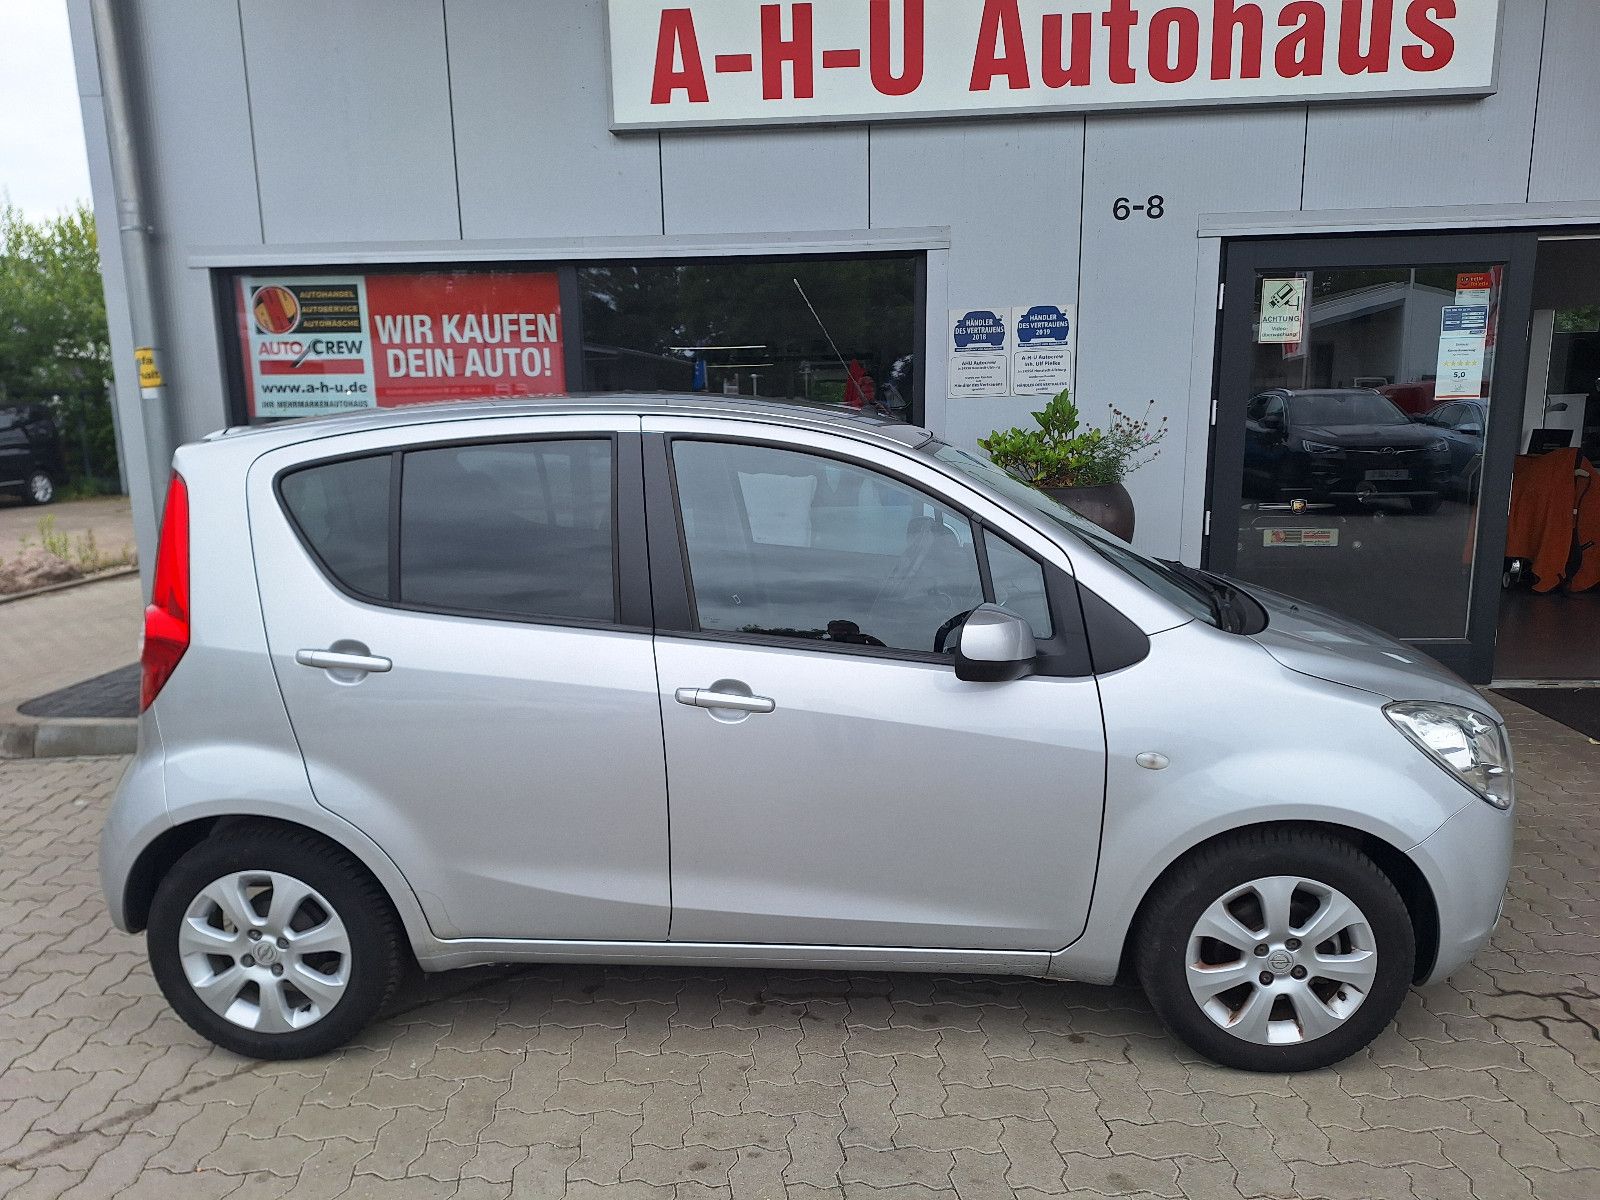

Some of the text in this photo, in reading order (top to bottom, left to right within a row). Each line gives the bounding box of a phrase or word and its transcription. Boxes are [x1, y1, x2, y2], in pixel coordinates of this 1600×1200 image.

[650, 0, 1457, 104] A-H-U Autohaus
[1112, 194, 1165, 220] 6-8
[302, 305, 359, 313] AUTOSERVICE
[965, 317, 994, 327] HÄNDLER
[1029, 313, 1057, 322] HÄNDLER
[1262, 315, 1300, 323] ACHTUNG
[374, 313, 558, 344] WIR KAUFEN
[1030, 320, 1068, 329] VERTRAUENS
[955, 325, 1004, 335] DES VERTRAUENS
[1035, 328, 1051, 336] 2019
[972, 333, 987, 341] 2018
[258, 339, 363, 356] AUTO CREW
[386, 346, 552, 378] DEIN AUTO!
[1453, 371, 1466, 379] 5,0
[261, 381, 368, 394] www.a-h-u.de
